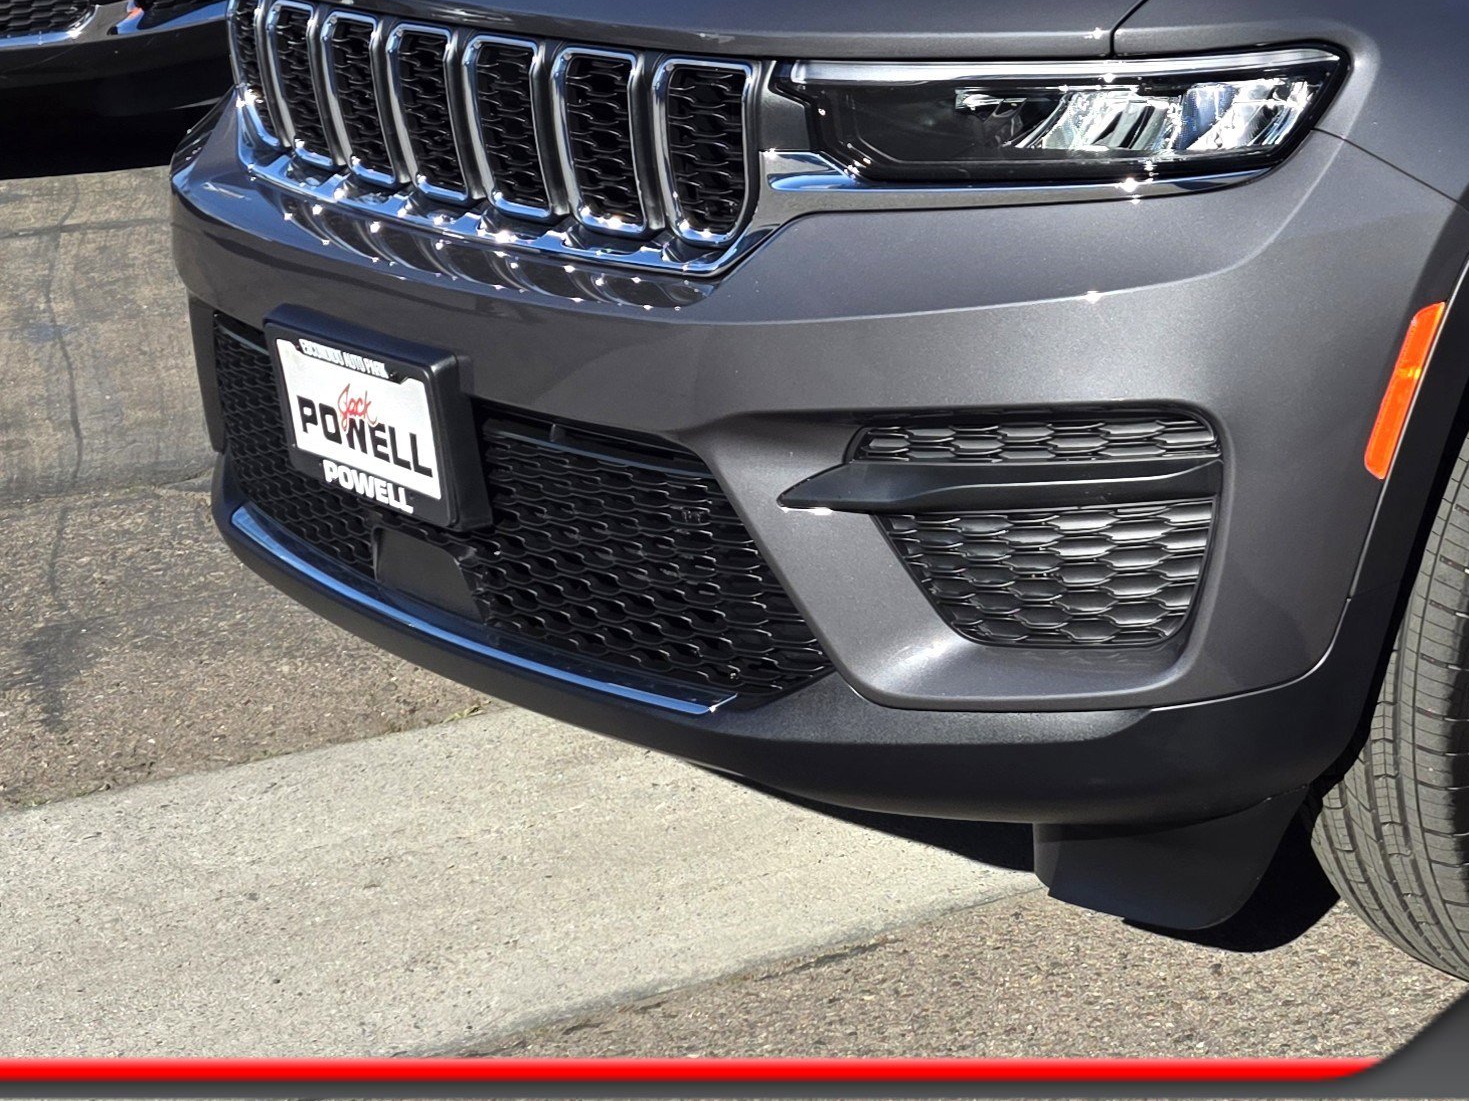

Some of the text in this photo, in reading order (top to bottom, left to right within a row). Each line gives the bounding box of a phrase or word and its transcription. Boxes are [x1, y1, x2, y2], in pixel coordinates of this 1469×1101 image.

[337, 383, 377, 431] Jack
[297, 395, 433, 478] POWELL
[322, 459, 414, 514] POWELL
